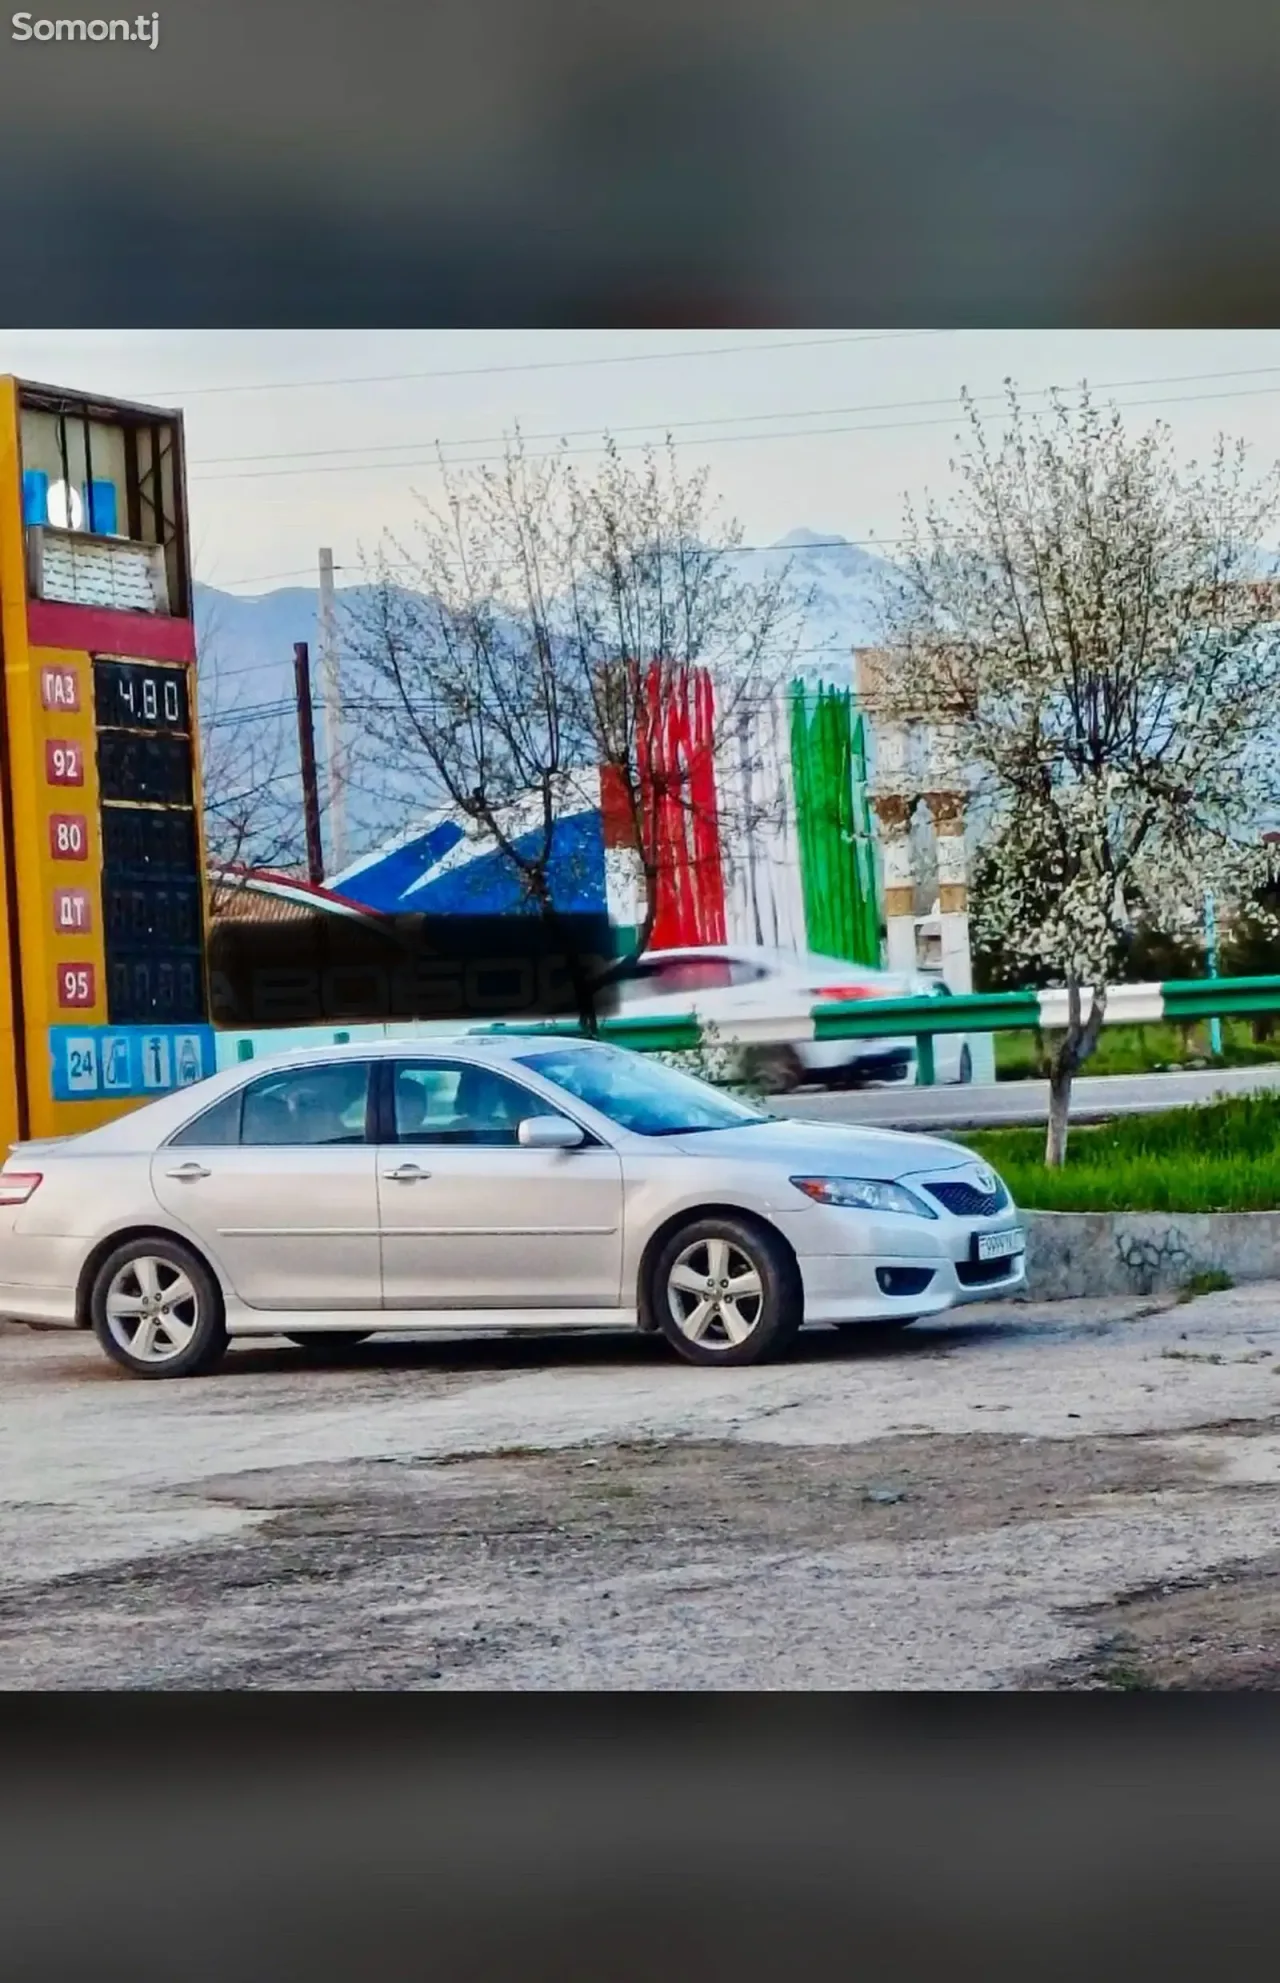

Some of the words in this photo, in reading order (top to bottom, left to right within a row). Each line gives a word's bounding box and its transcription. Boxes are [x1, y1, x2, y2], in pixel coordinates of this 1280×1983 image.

[45, 674, 75, 704] ГАЗ
[119, 679, 179, 721] 4.80
[53, 749, 78, 777] 92
[57, 823, 81, 851] 80
[60, 896, 84, 926] ДТ
[65, 971, 88, 999] 95
[70, 1051, 93, 1077] 24
